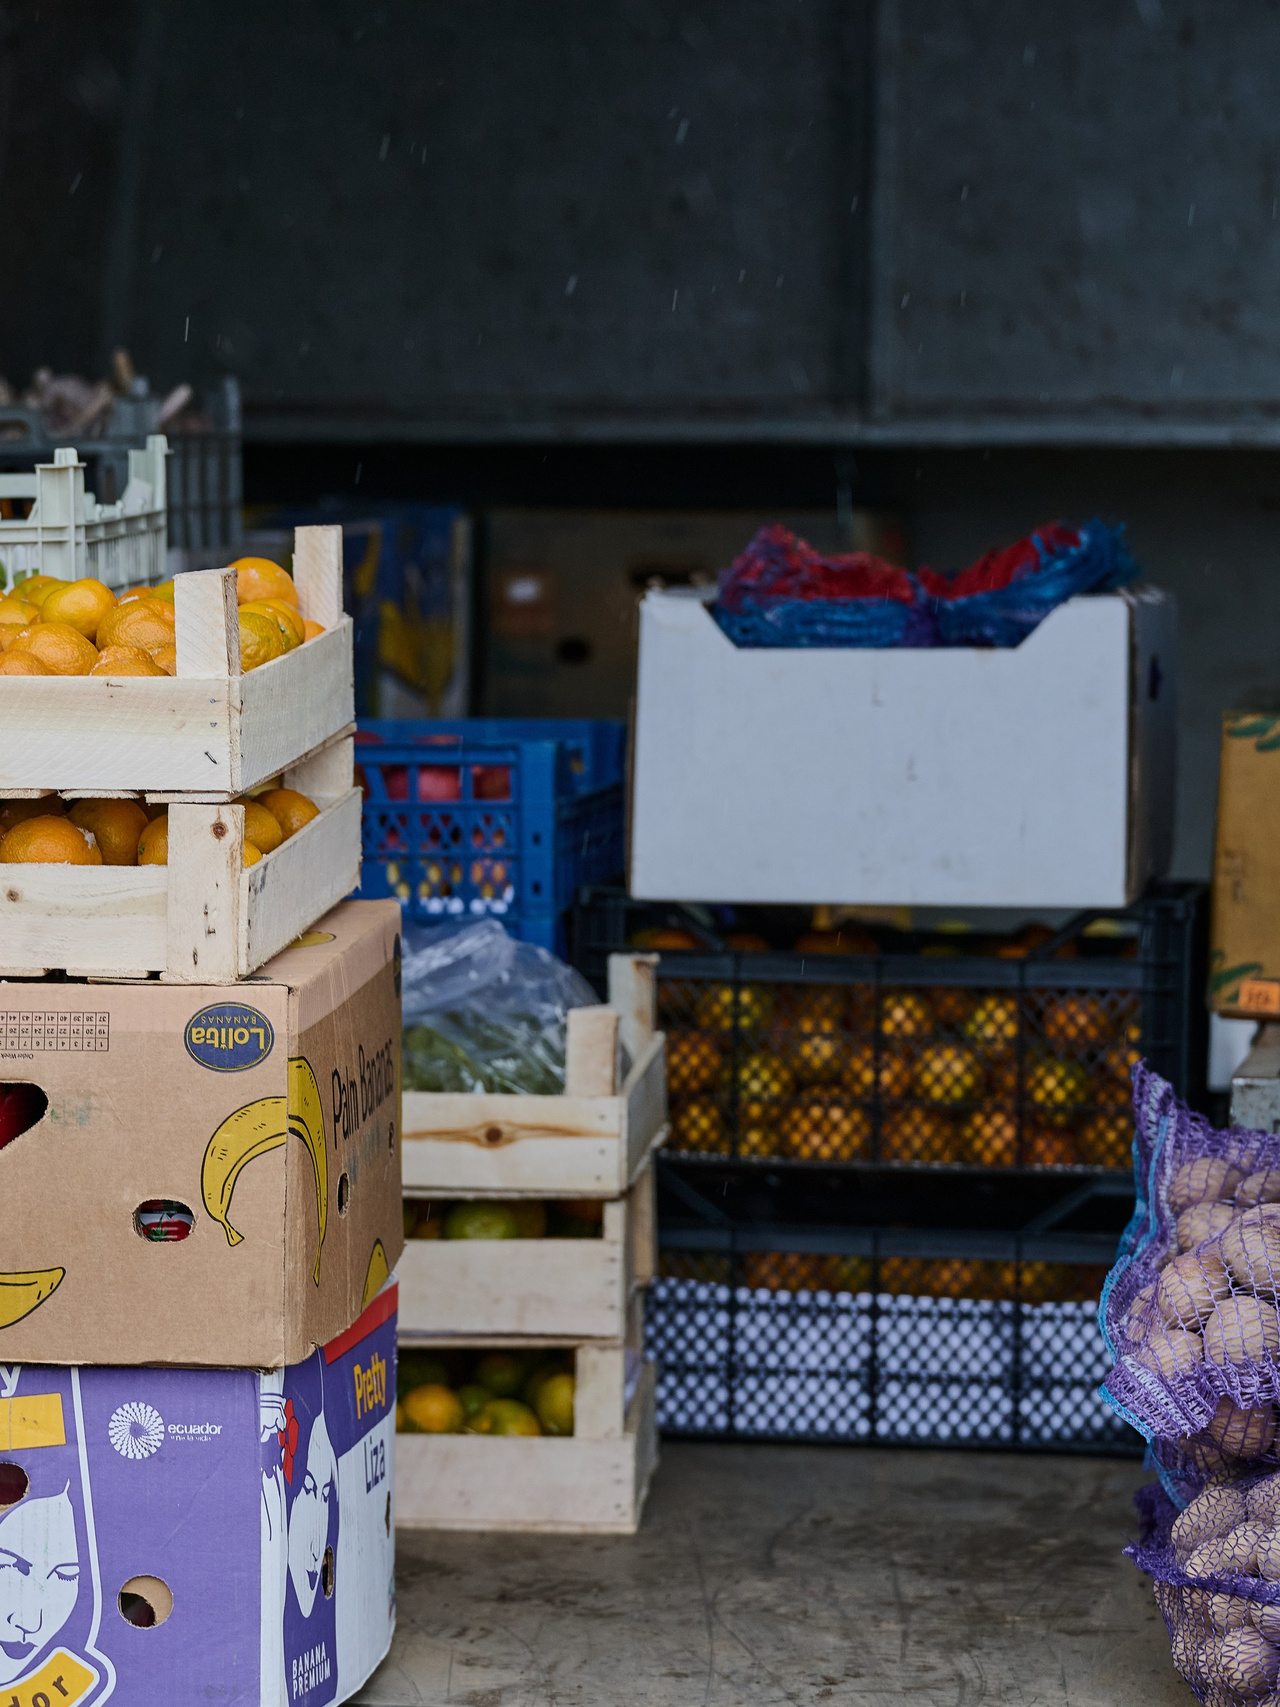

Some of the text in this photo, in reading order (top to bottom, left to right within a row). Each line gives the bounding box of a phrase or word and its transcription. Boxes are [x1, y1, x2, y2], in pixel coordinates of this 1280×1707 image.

[191, 1026, 265, 1050] Lolita
[201, 1015, 258, 1024] BANANAS
[332, 1067, 360, 1150] Palm
[353, 1352, 386, 1420] Pretty
[168, 1422, 222, 1434] ecuador
[364, 1435, 386, 1494] Liza
[292, 1641, 326, 1680] BANANA
[292, 1658, 330, 1700] PREMIUM
